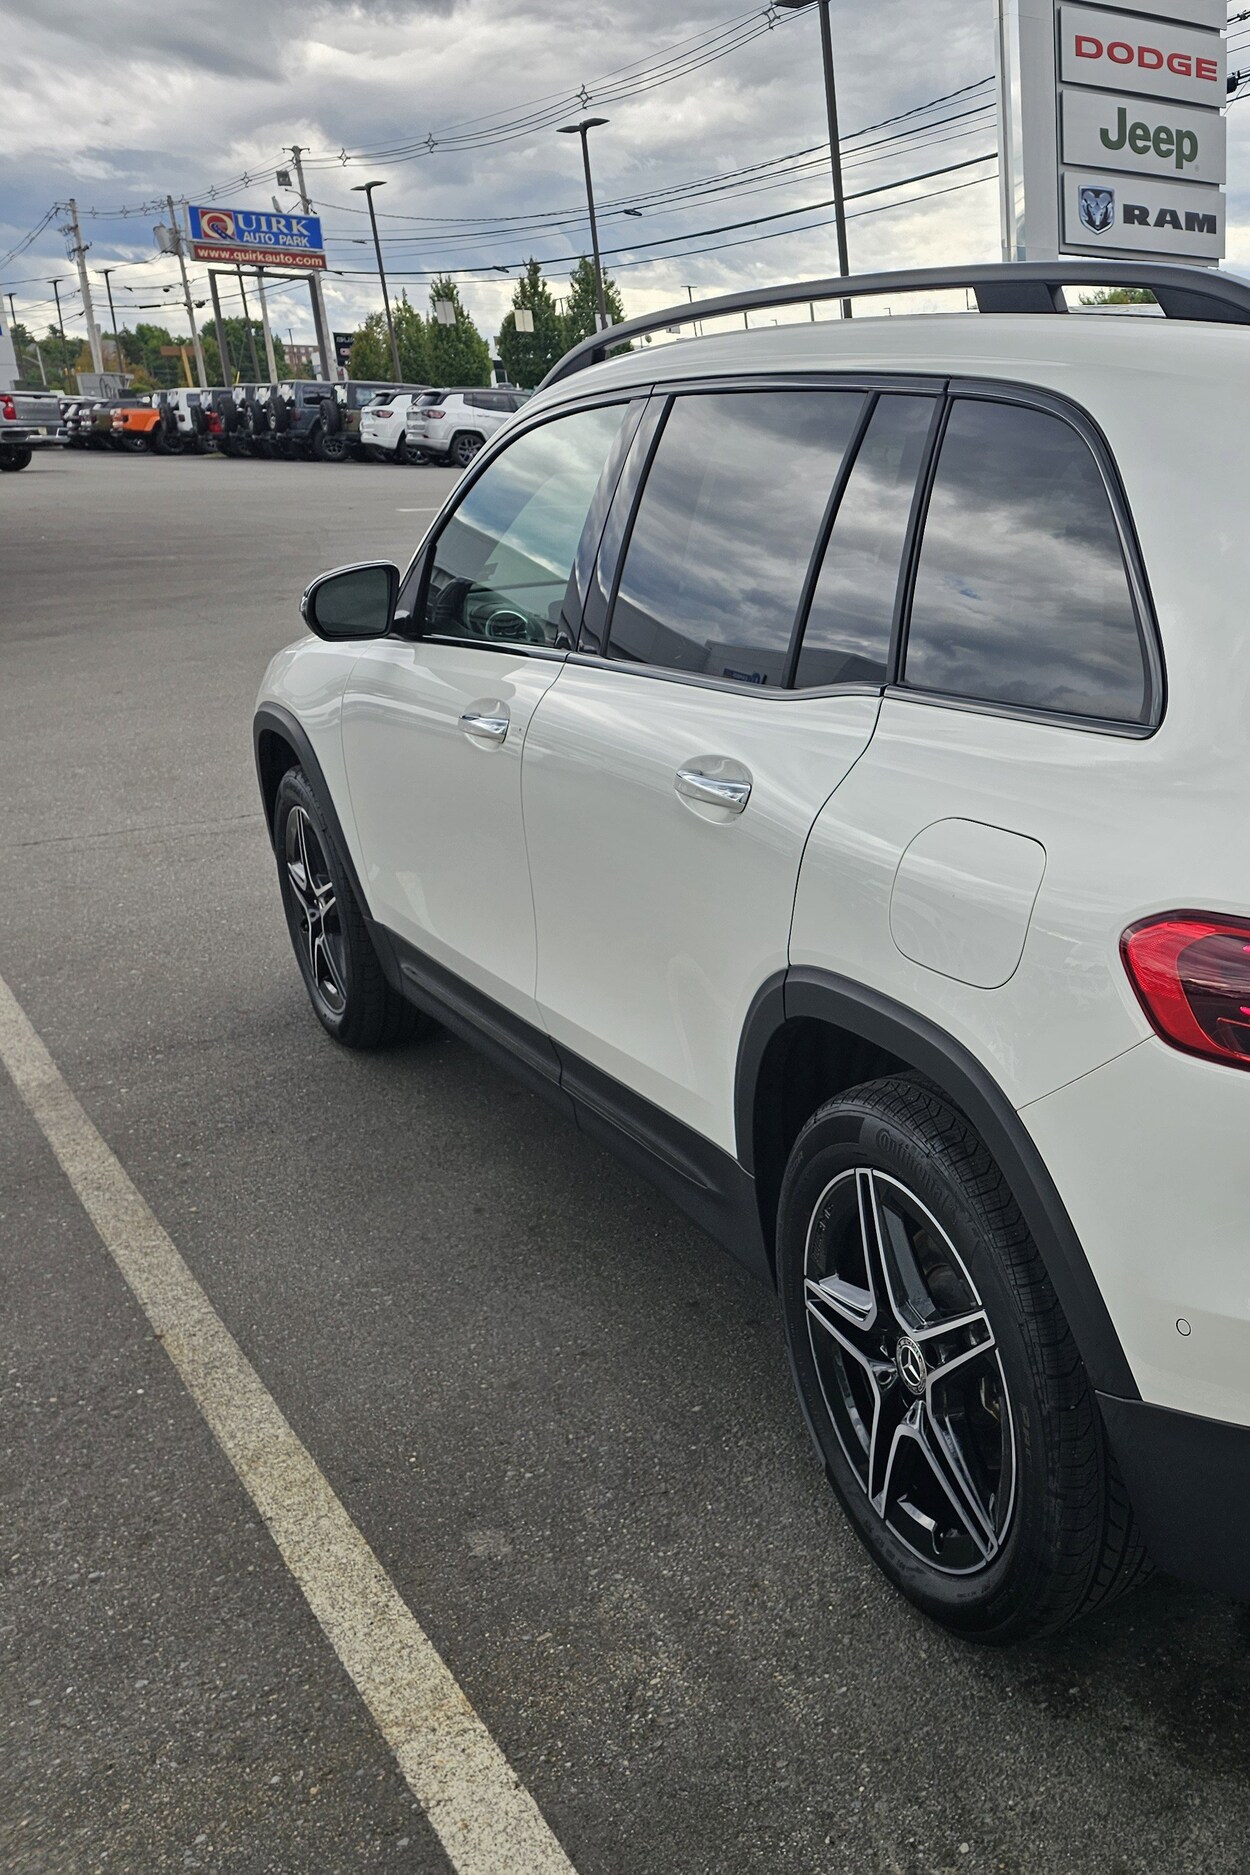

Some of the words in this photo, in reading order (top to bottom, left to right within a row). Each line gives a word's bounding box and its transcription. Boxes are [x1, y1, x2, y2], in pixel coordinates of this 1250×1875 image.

[1074, 34, 1218, 82] DODGE
[1099, 106, 1199, 169] Jeep
[201, 211, 312, 242] QUIRK
[1122, 203, 1217, 235] RAM
[243, 231, 275, 245] AUTO
[278, 234, 311, 248] PARK
[197, 248, 323, 267] www.quirkauto.com
